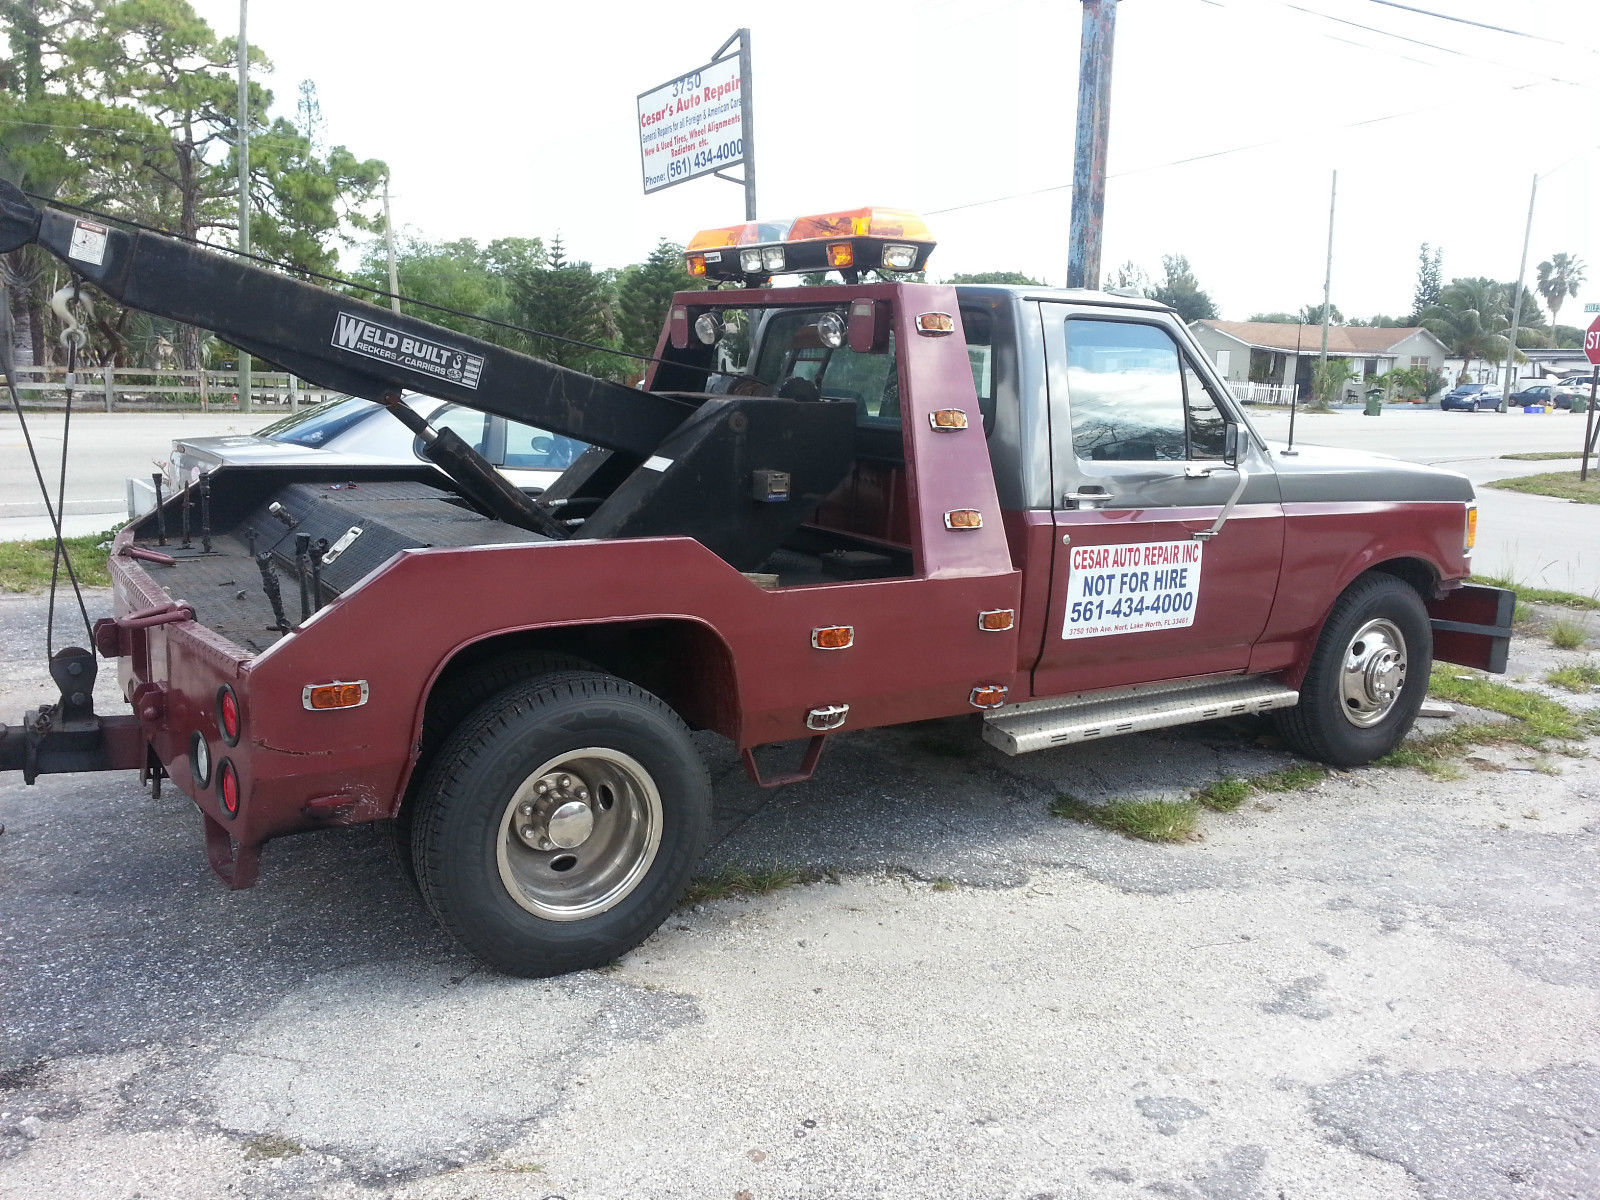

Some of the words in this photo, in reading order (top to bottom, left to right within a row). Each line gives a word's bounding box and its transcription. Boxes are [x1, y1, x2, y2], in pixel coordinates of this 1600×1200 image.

[672, 72, 702, 98] 3750
[641, 103, 674, 128] Cesar's
[676, 94, 701, 114] Auto
[703, 75, 741, 101] Repair
[642, 129, 657, 144] General
[657, 125, 673, 139] Repairs
[685, 113, 702, 126] Foreign
[707, 102, 730, 117] American
[730, 98, 742, 109] Cars
[644, 146, 655, 158] New
[656, 143, 660, 153] &
[660, 138, 673, 151] Used
[673, 134, 688, 146] Tires,
[689, 124, 707, 140] Wheel
[707, 114, 741, 133] Alignments
[645, 172, 666, 187] Phone:
[666, 157, 691, 183] (561)
[694, 138, 743, 169] 434-4000
[671, 141, 696, 158] Radiators
[698, 137, 709, 148] etc.
[338, 315, 399, 349] WELD
[400, 337, 451, 365] BUILT
[1073, 548, 1110, 570] CESAR
[1112, 546, 1141, 568] AUTO
[1143, 544, 1180, 566] REPAIR
[1182, 543, 1199, 564] INC
[1082, 573, 1116, 597] NOT
[1119, 571, 1150, 594] FOR
[1153, 567, 1188, 591] HIRE
[1070, 591, 1193, 623] 561-434-4000
[1069, 627, 1084, 636] 3750
[1085, 626, 1099, 634] 10th
[1129, 622, 1144, 630] Lake
[1163, 618, 1171, 626] FL
[1171, 616, 1189, 625] 33461
